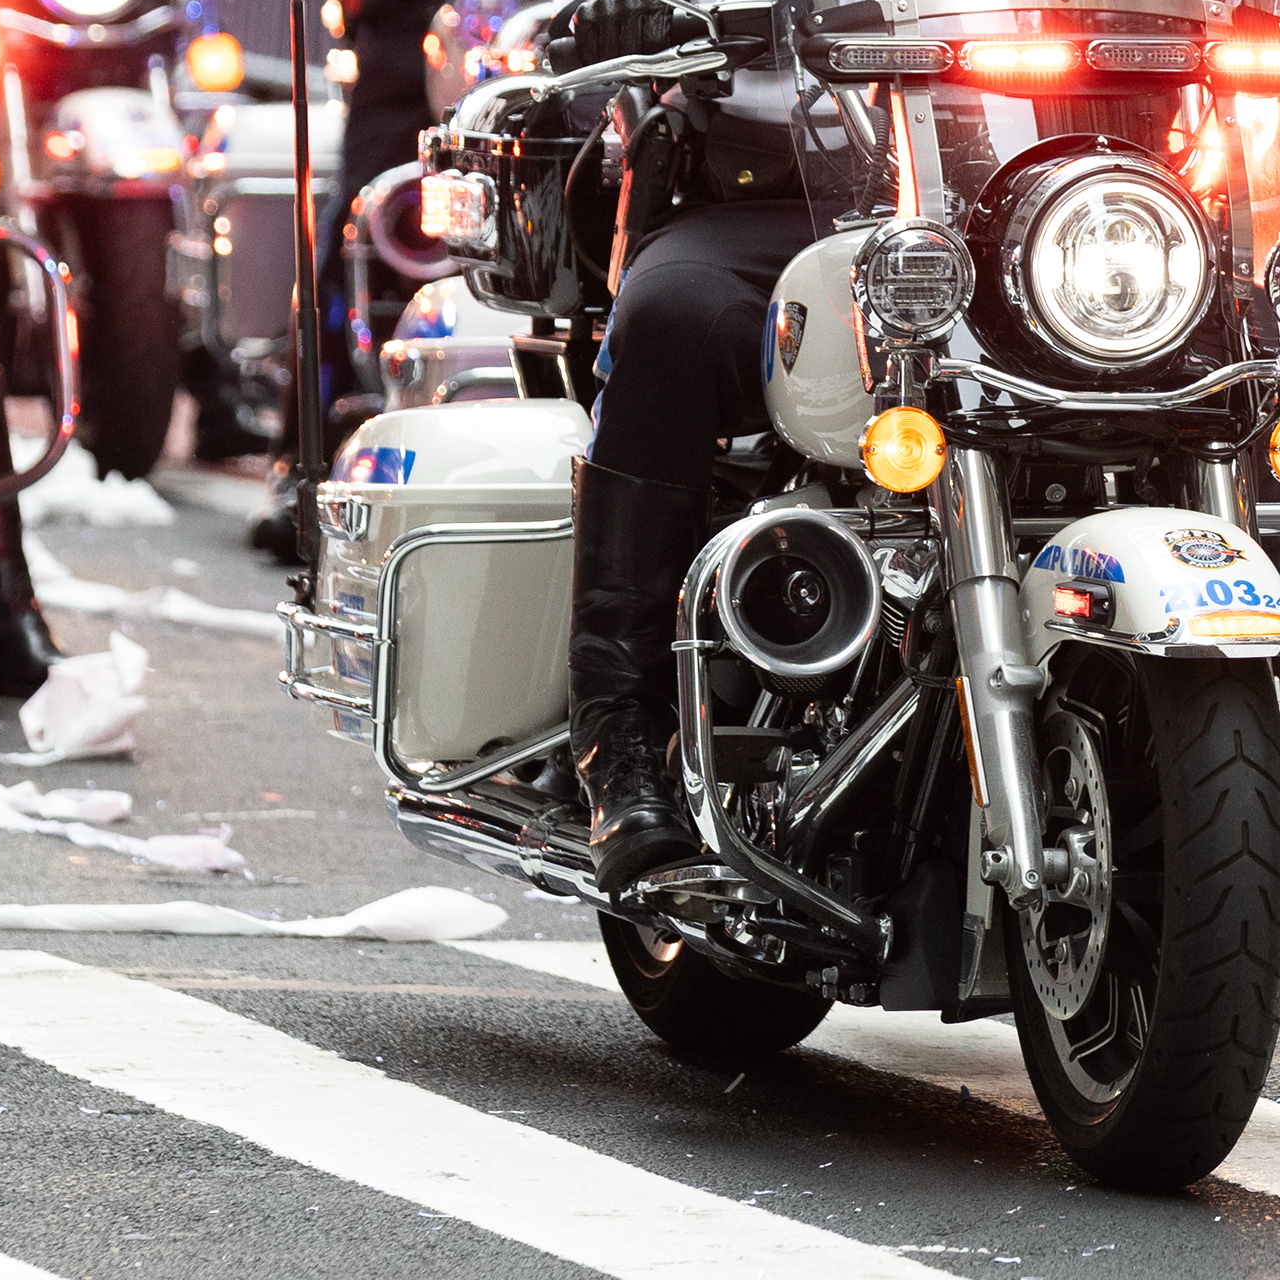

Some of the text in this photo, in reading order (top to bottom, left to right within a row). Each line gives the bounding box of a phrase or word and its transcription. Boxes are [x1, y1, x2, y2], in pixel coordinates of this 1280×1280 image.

[1165, 529, 1222, 543] NYPD
[1050, 546, 1108, 579] POLICE
[1188, 560, 1231, 568] PATROL
[1159, 579, 1261, 613] 2103
